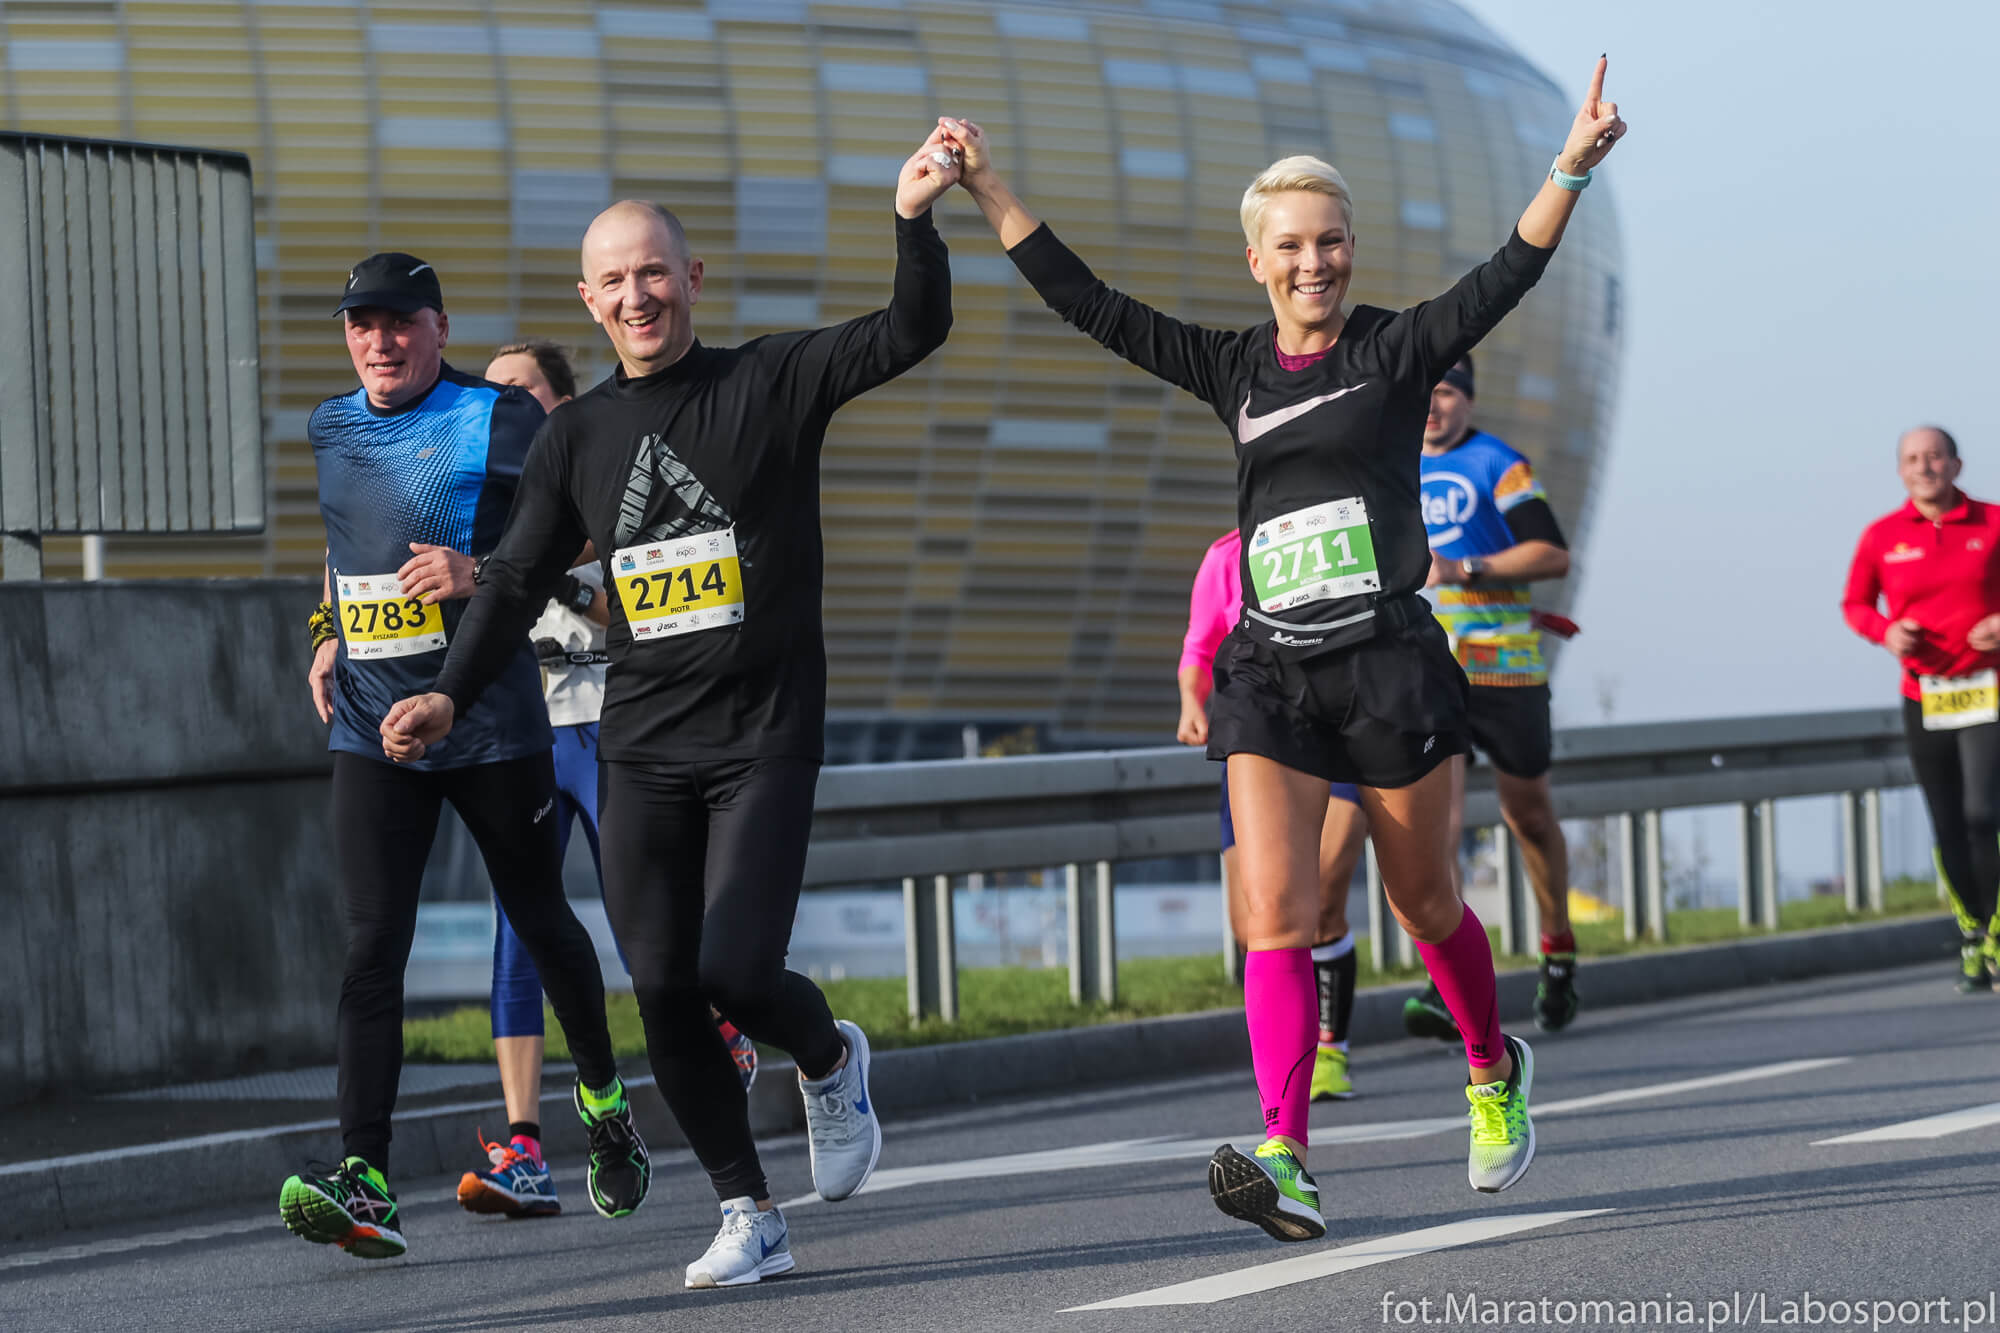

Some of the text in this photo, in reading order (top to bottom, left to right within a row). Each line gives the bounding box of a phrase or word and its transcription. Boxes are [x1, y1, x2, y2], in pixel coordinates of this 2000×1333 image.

[1421, 488, 1457, 525] tel
[1263, 530, 1359, 589] 2711
[630, 562, 727, 612] 2714
[347, 599, 427, 633] 2783
[670, 604, 690, 614] PIOTR
